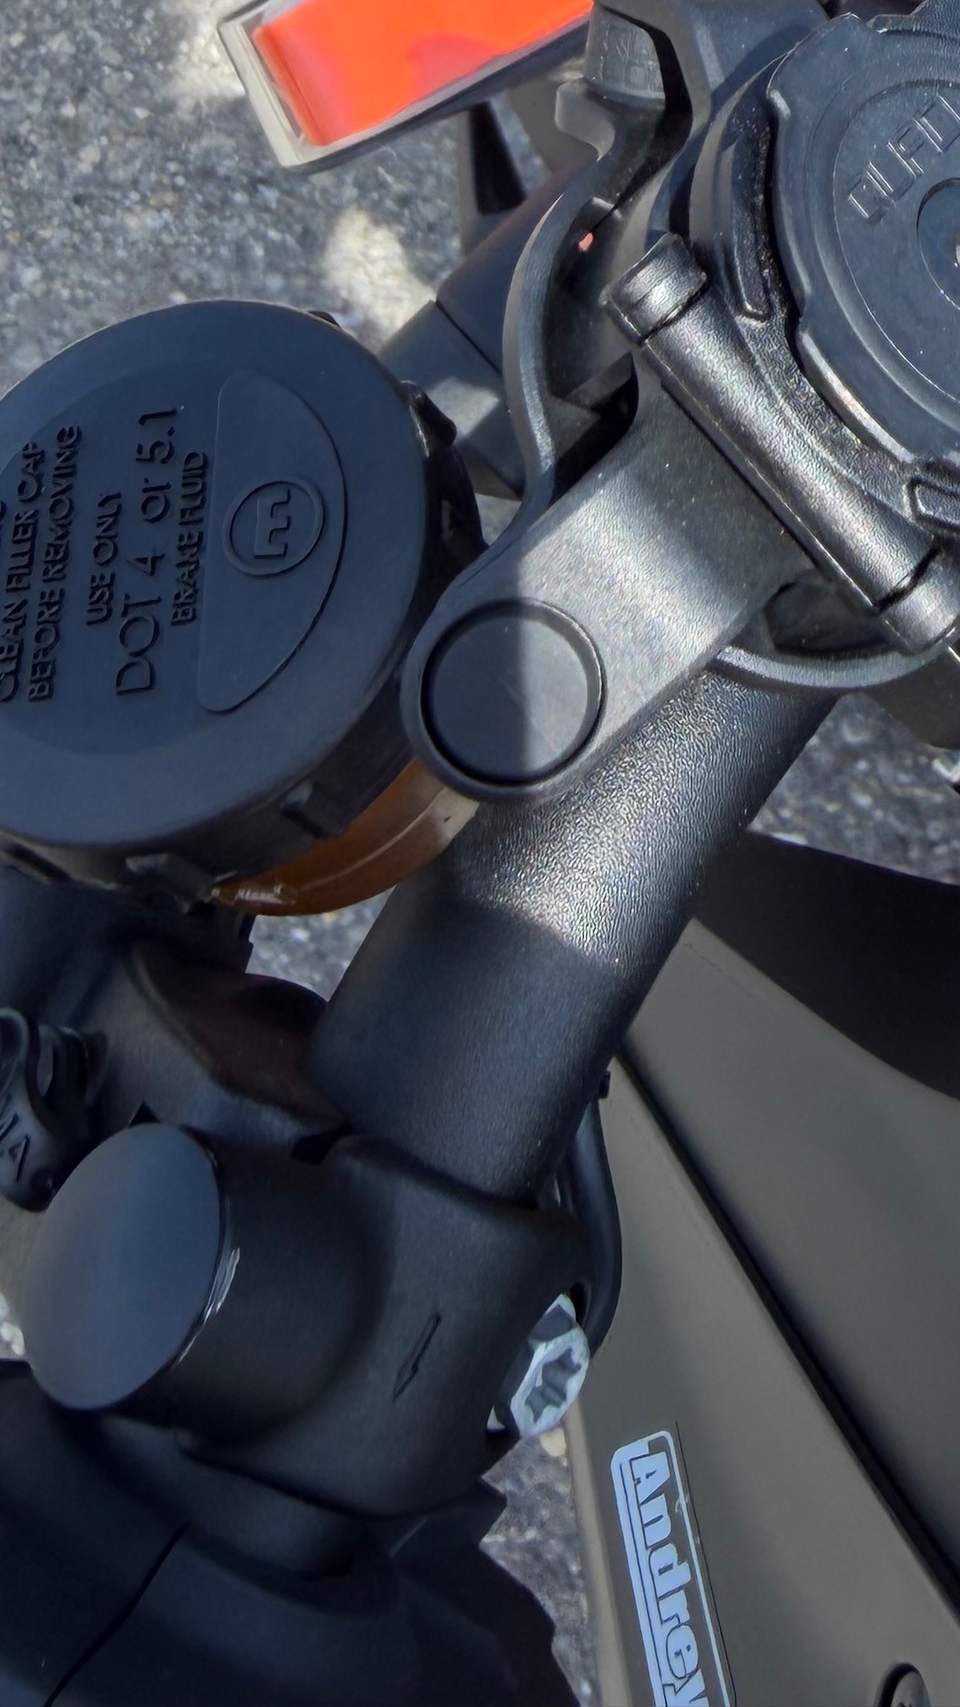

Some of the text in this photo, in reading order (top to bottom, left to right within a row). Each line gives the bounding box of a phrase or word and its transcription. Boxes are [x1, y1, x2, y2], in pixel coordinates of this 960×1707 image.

[0, 442, 45, 703] CLEAN FILLER CAP
[28, 425, 82, 703] BEFORE REMOVING
[86, 492, 122, 626] USE ONLY
[116, 407, 178, 696] DOT 4 or 5.1
[170, 451, 209, 626] BRAKE FLUID
